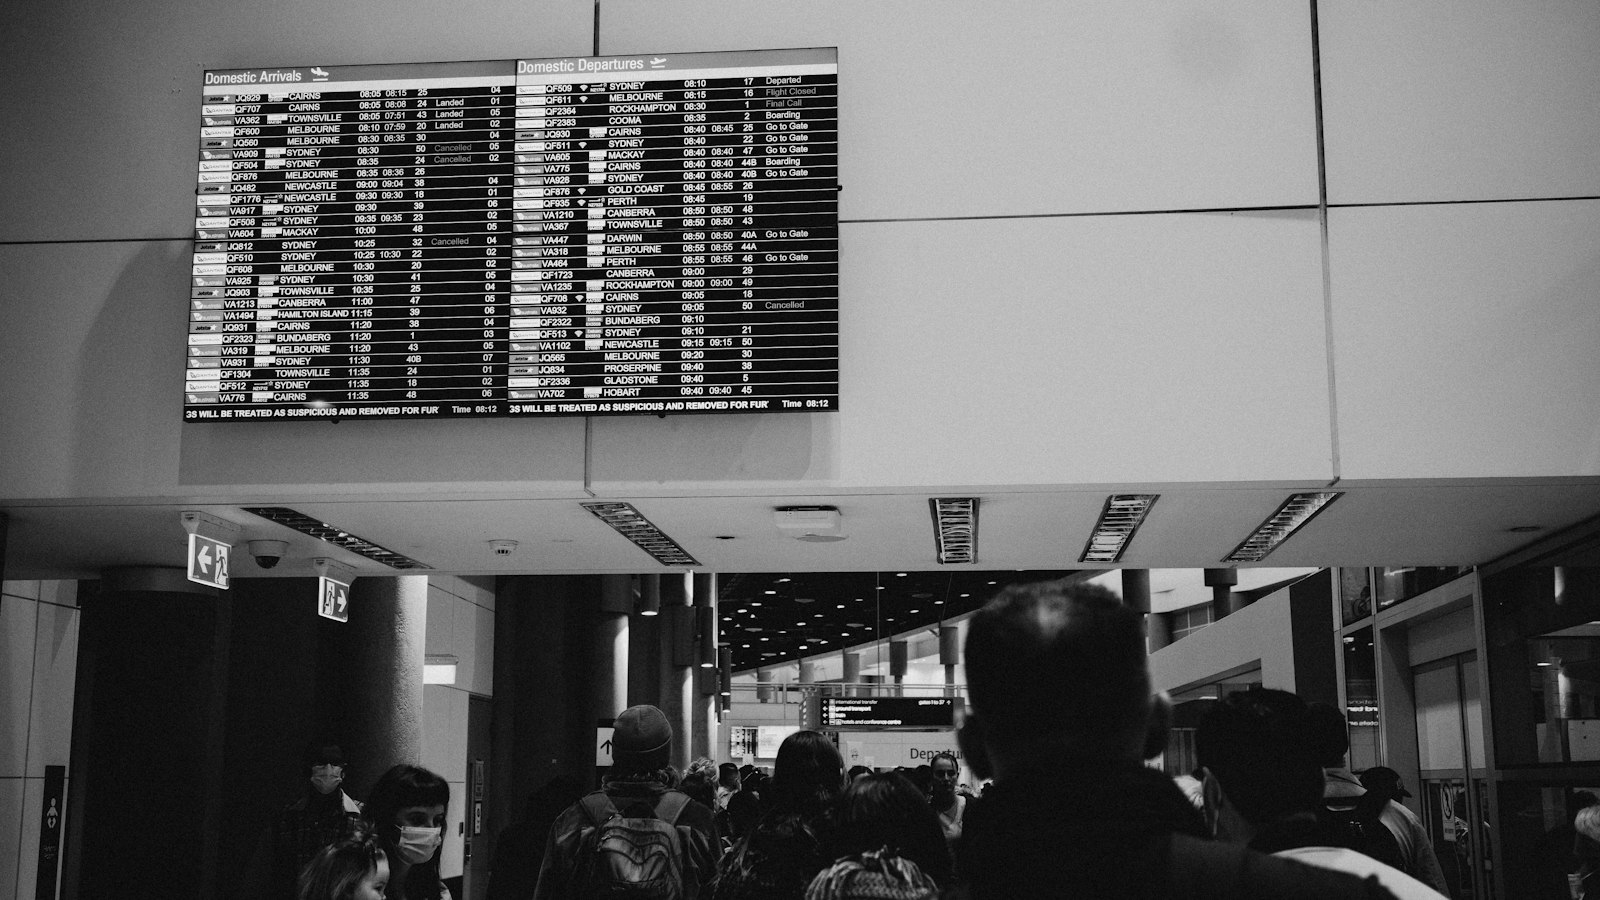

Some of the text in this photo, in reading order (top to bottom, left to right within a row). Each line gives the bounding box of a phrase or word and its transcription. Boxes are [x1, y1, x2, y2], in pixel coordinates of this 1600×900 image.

[518, 58, 644, 74] Domestic Departures
[206, 70, 302, 84] Domestic Arrivals
[546, 85, 571, 93] QF509
[610, 82, 644, 90] SYDNEY
[684, 80, 706, 88] 08:10
[743, 78, 753, 86] 17
[766, 77, 801, 86] Departed
[609, 93, 663, 102] MELBOURNE
[684, 91, 706, 99] 08:15
[766, 88, 787, 97] Flight
[789, 87, 816, 95] Closed
[235, 105, 260, 113] QF707
[288, 104, 320, 112] CAIRNS
[436, 99, 464, 107] Landed
[288, 114, 341, 123] TOWNSVILLE
[385, 112, 406, 120] 07:51
[417, 111, 427, 119] 43
[436, 110, 463, 118] Landed
[609, 128, 641, 136] CAIRNS
[684, 126, 706, 134] 08:40
[743, 124, 753, 132] 25
[766, 123, 778, 131] Go
[790, 122, 808, 130] Gate
[233, 150, 258, 158] VA909
[286, 149, 321, 157] SYDNEY
[416, 145, 426, 153] 50
[434, 144, 471, 152] Cancelled
[544, 165, 570, 173] VA775
[608, 163, 640, 171] CAIRNS
[766, 158, 800, 167] Boarding
[285, 171, 338, 179] MELBOURNE
[608, 186, 632, 194] GOLD
[634, 185, 664, 193] COAST
[711, 183, 733, 191] 08:55
[743, 182, 753, 190] 26
[284, 193, 337, 202] NEWCASTLE
[356, 192, 377, 200] 09:30
[282, 240, 316, 250] SYDNEY
[354, 239, 376, 248] 10:25
[412, 238, 422, 246] 32
[431, 237, 468, 246] Cancelled
[487, 236, 497, 244] 04
[543, 236, 568, 244] VA447
[607, 234, 642, 243] DARWIN
[683, 232, 705, 241] 08:50
[711, 232, 733, 240] 08:50
[741, 231, 756, 239] 40A
[790, 230, 808, 238] Gate
[541, 283, 572, 291] VA1235
[606, 280, 673, 290] ROCKHAMPTON
[682, 280, 704, 288] 09:00
[710, 279, 732, 287] 09:00
[224, 312, 254, 320] VA1494
[278, 310, 319, 319] HAMILTON
[321, 310, 349, 318] ISLAND
[410, 308, 420, 316] 39
[485, 307, 495, 315] 06
[222, 342, 494, 355] VA319 MELBOURNE 11:20 43 05
[540, 342, 570, 350] VA1102
[605, 340, 659, 349] NEWCASTLE
[682, 339, 704, 347] 09:15
[710, 339, 732, 347] 09:15
[742, 338, 752, 346] 50
[221, 366, 493, 379] QF1304 TOWNSVILLE 11:35 24 01
[604, 376, 658, 385] GLADSTONE
[681, 375, 703, 383] 09:40
[743, 374, 748, 382] 5
[475, 405, 497, 413] 08:12
[558, 404, 597, 412] TREATED
[599, 403, 611, 411] AS
[612, 403, 664, 411] SUSPICIOUS
[666, 402, 684, 410] AND
[686, 401, 728, 410] REMOVED
[730, 401, 748, 409] FOR
[782, 400, 828, 408] Time 08:12
[199, 410, 219, 418] WILL
[234, 409, 272, 417] TREATED
[287, 408, 337, 416] SUSPICIOUS
[359, 407, 399, 415] REMOVED
